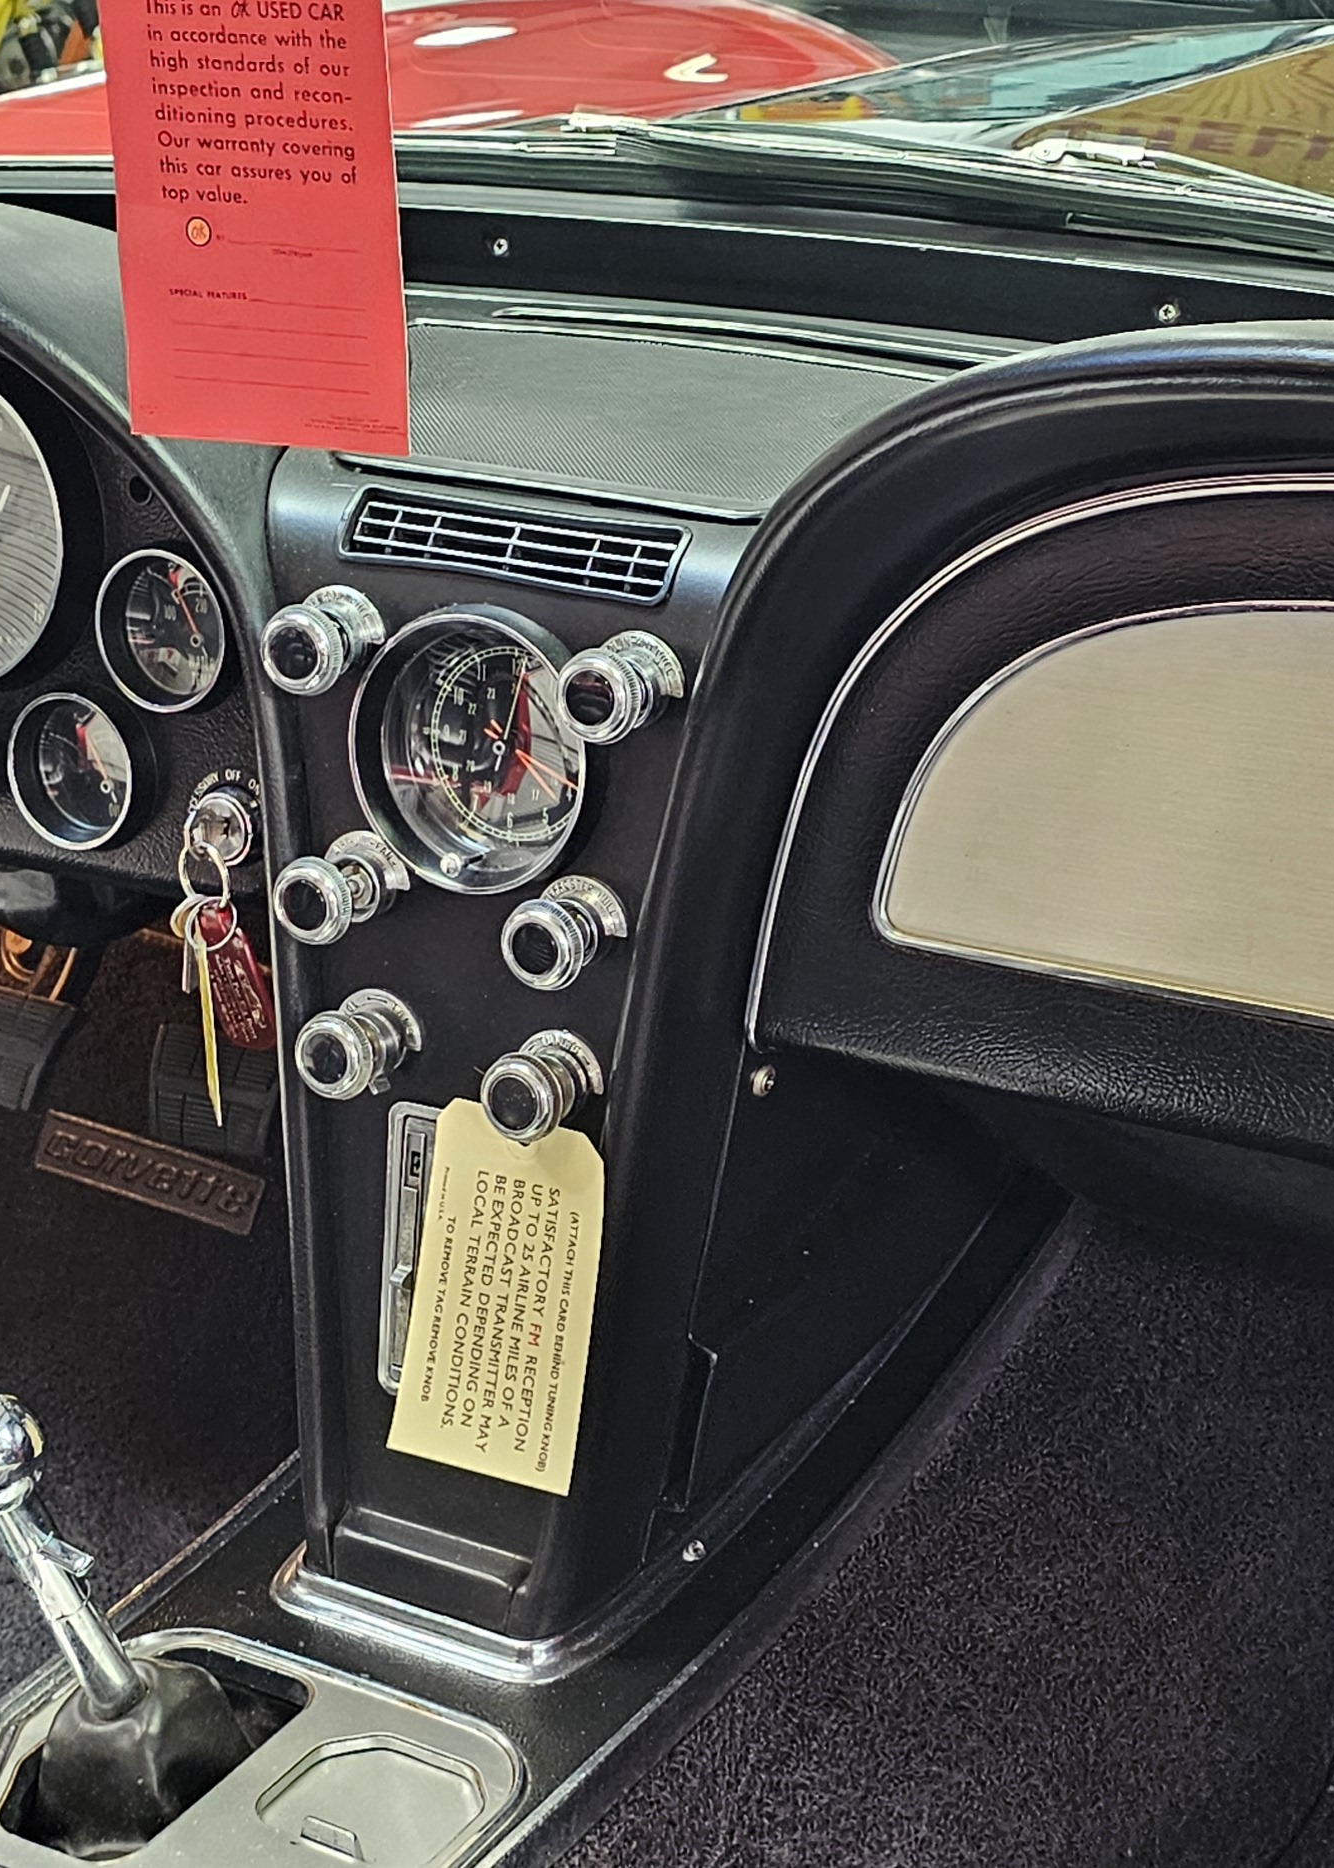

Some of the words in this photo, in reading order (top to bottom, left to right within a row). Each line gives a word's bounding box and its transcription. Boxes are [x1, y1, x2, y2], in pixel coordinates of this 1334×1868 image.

[146, 0, 176, 16] This
[180, 1, 194, 16] is
[198, 3, 222, 17] an
[230, 0, 251, 19] OK
[256, 1, 304, 21] USED
[307, 4, 345, 22] CAR
[147, 24, 163, 42] in
[170, 23, 268, 46] accordance
[275, 28, 313, 49] with
[319, 29, 347, 50] the
[150, 48, 189, 73] high
[197, 52, 285, 74] standards
[293, 56, 310, 75] of
[319, 64, 351, 77] our
[151, 76, 242, 100] inspection
[250, 82, 285, 101] and
[294, 89, 353, 105] recon-
[155, 102, 237, 128] ditioning
[244, 110, 353, 132] procedures.
[157, 130, 191, 149] Our
[196, 137, 276, 157] warranty
[282, 140, 356, 162] covering
[159, 155, 189, 174] this
[196, 163, 222, 176] car
[231, 165, 292, 181] assures
[299, 170, 332, 185] you
[341, 165, 357, 185] of
[162, 185, 190, 204] top
[196, 184, 248, 205] value.
[169, 288, 203, 299] SPECIAL
[207, 291, 247, 301] FEATURES
[454, 687, 464, 705] 10
[225, 768, 241, 781] OFF
[506, 812, 514, 828] 6
[542, 808, 549, 824] 5
[470, 1169, 490, 1229] LOCAL
[493, 1173, 508, 1196] BE
[530, 1183, 544, 1208] UP
[446, 1215, 457, 1235] TO
[499, 1178, 527, 1289] BROADCAST
[526, 1211, 541, 1238] TO
[565, 1210, 580, 1267] (ATTACH
[481, 1198, 505, 1287] EXPECTED
[522, 1242, 536, 1262] 25
[532, 1186, 561, 1318] SATISFACTORY
[438, 1236, 454, 1286] REMOVE
[459, 1234, 482, 1308] TERRAIN
[561, 1268, 574, 1296] THIS
[434, 1288, 447, 1314] TAG
[511, 1263, 532, 1333] AIRLINE
[556, 1297, 570, 1333] CARD
[426, 1314, 442, 1365] REMOVE
[466, 1291, 491, 1394] DEPENDING
[527, 1321, 543, 1347] FM
[481, 1292, 510, 1409] TRANSMITTER
[504, 1335, 522, 1383] MILES
[550, 1334, 564, 1380] BEHIND
[421, 1365, 434, 1402] KNOB
[440, 1311, 470, 1429] CONDITIONS.
[460, 1396, 476, 1428] ON
[501, 1385, 515, 1412] OF
[513, 1353, 538, 1453] RECEPTION
[543, 1382, 559, 1432] TUNING
[475, 1413, 493, 1454] MAY
[497, 1413, 511, 1428] A
[535, 1432, 551, 1473] KNOB)
